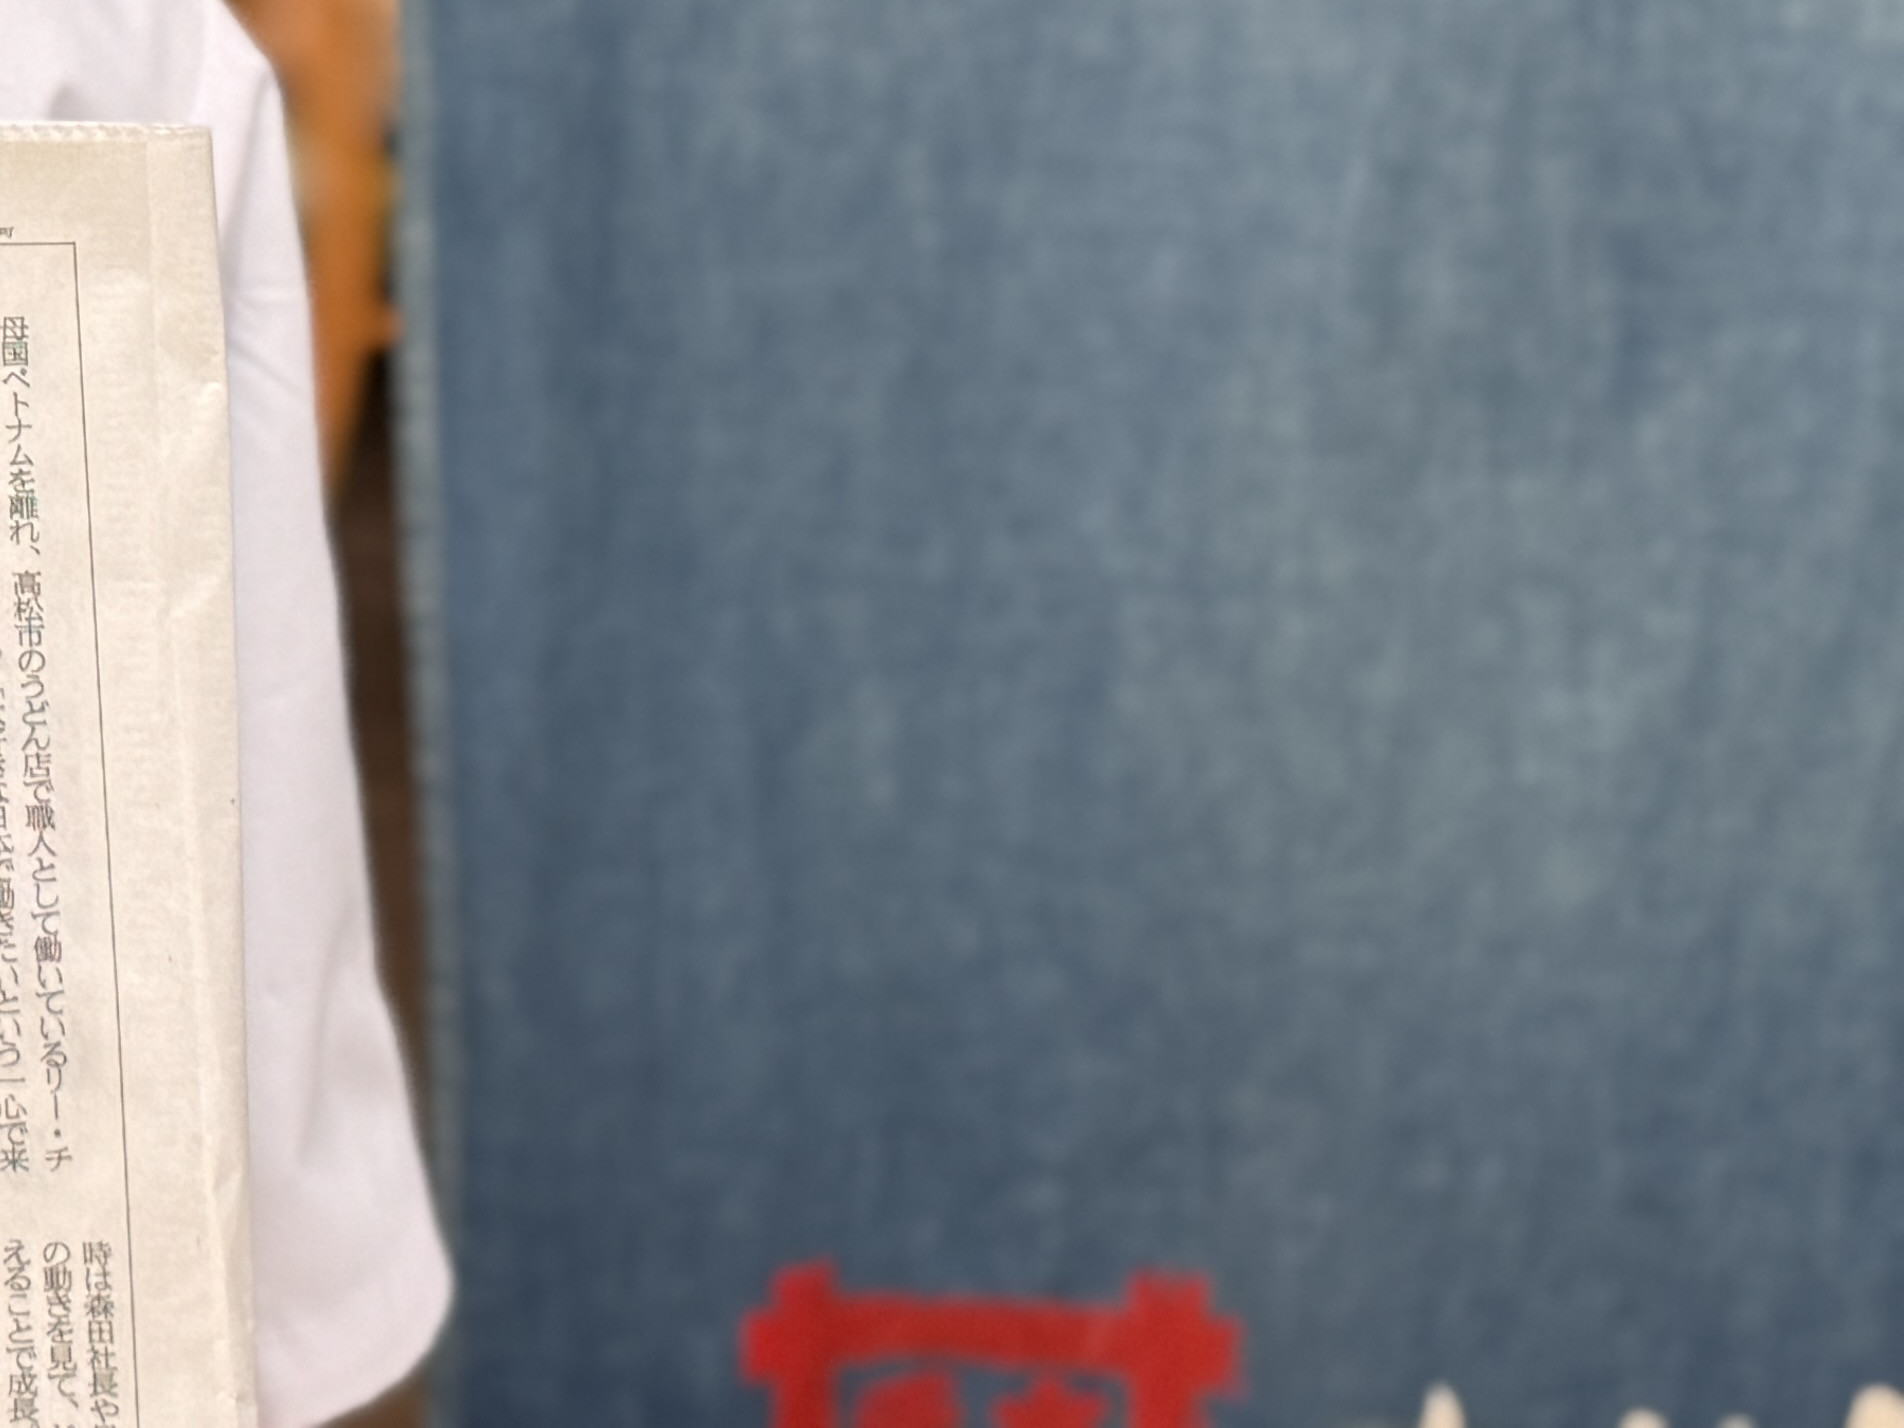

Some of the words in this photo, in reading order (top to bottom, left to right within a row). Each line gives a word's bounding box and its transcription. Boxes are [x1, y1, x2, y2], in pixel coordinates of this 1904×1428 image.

[43, 1242, 79, 1428] の動きを見て、
[83, 1241, 119, 1428] 時は森田社長や
